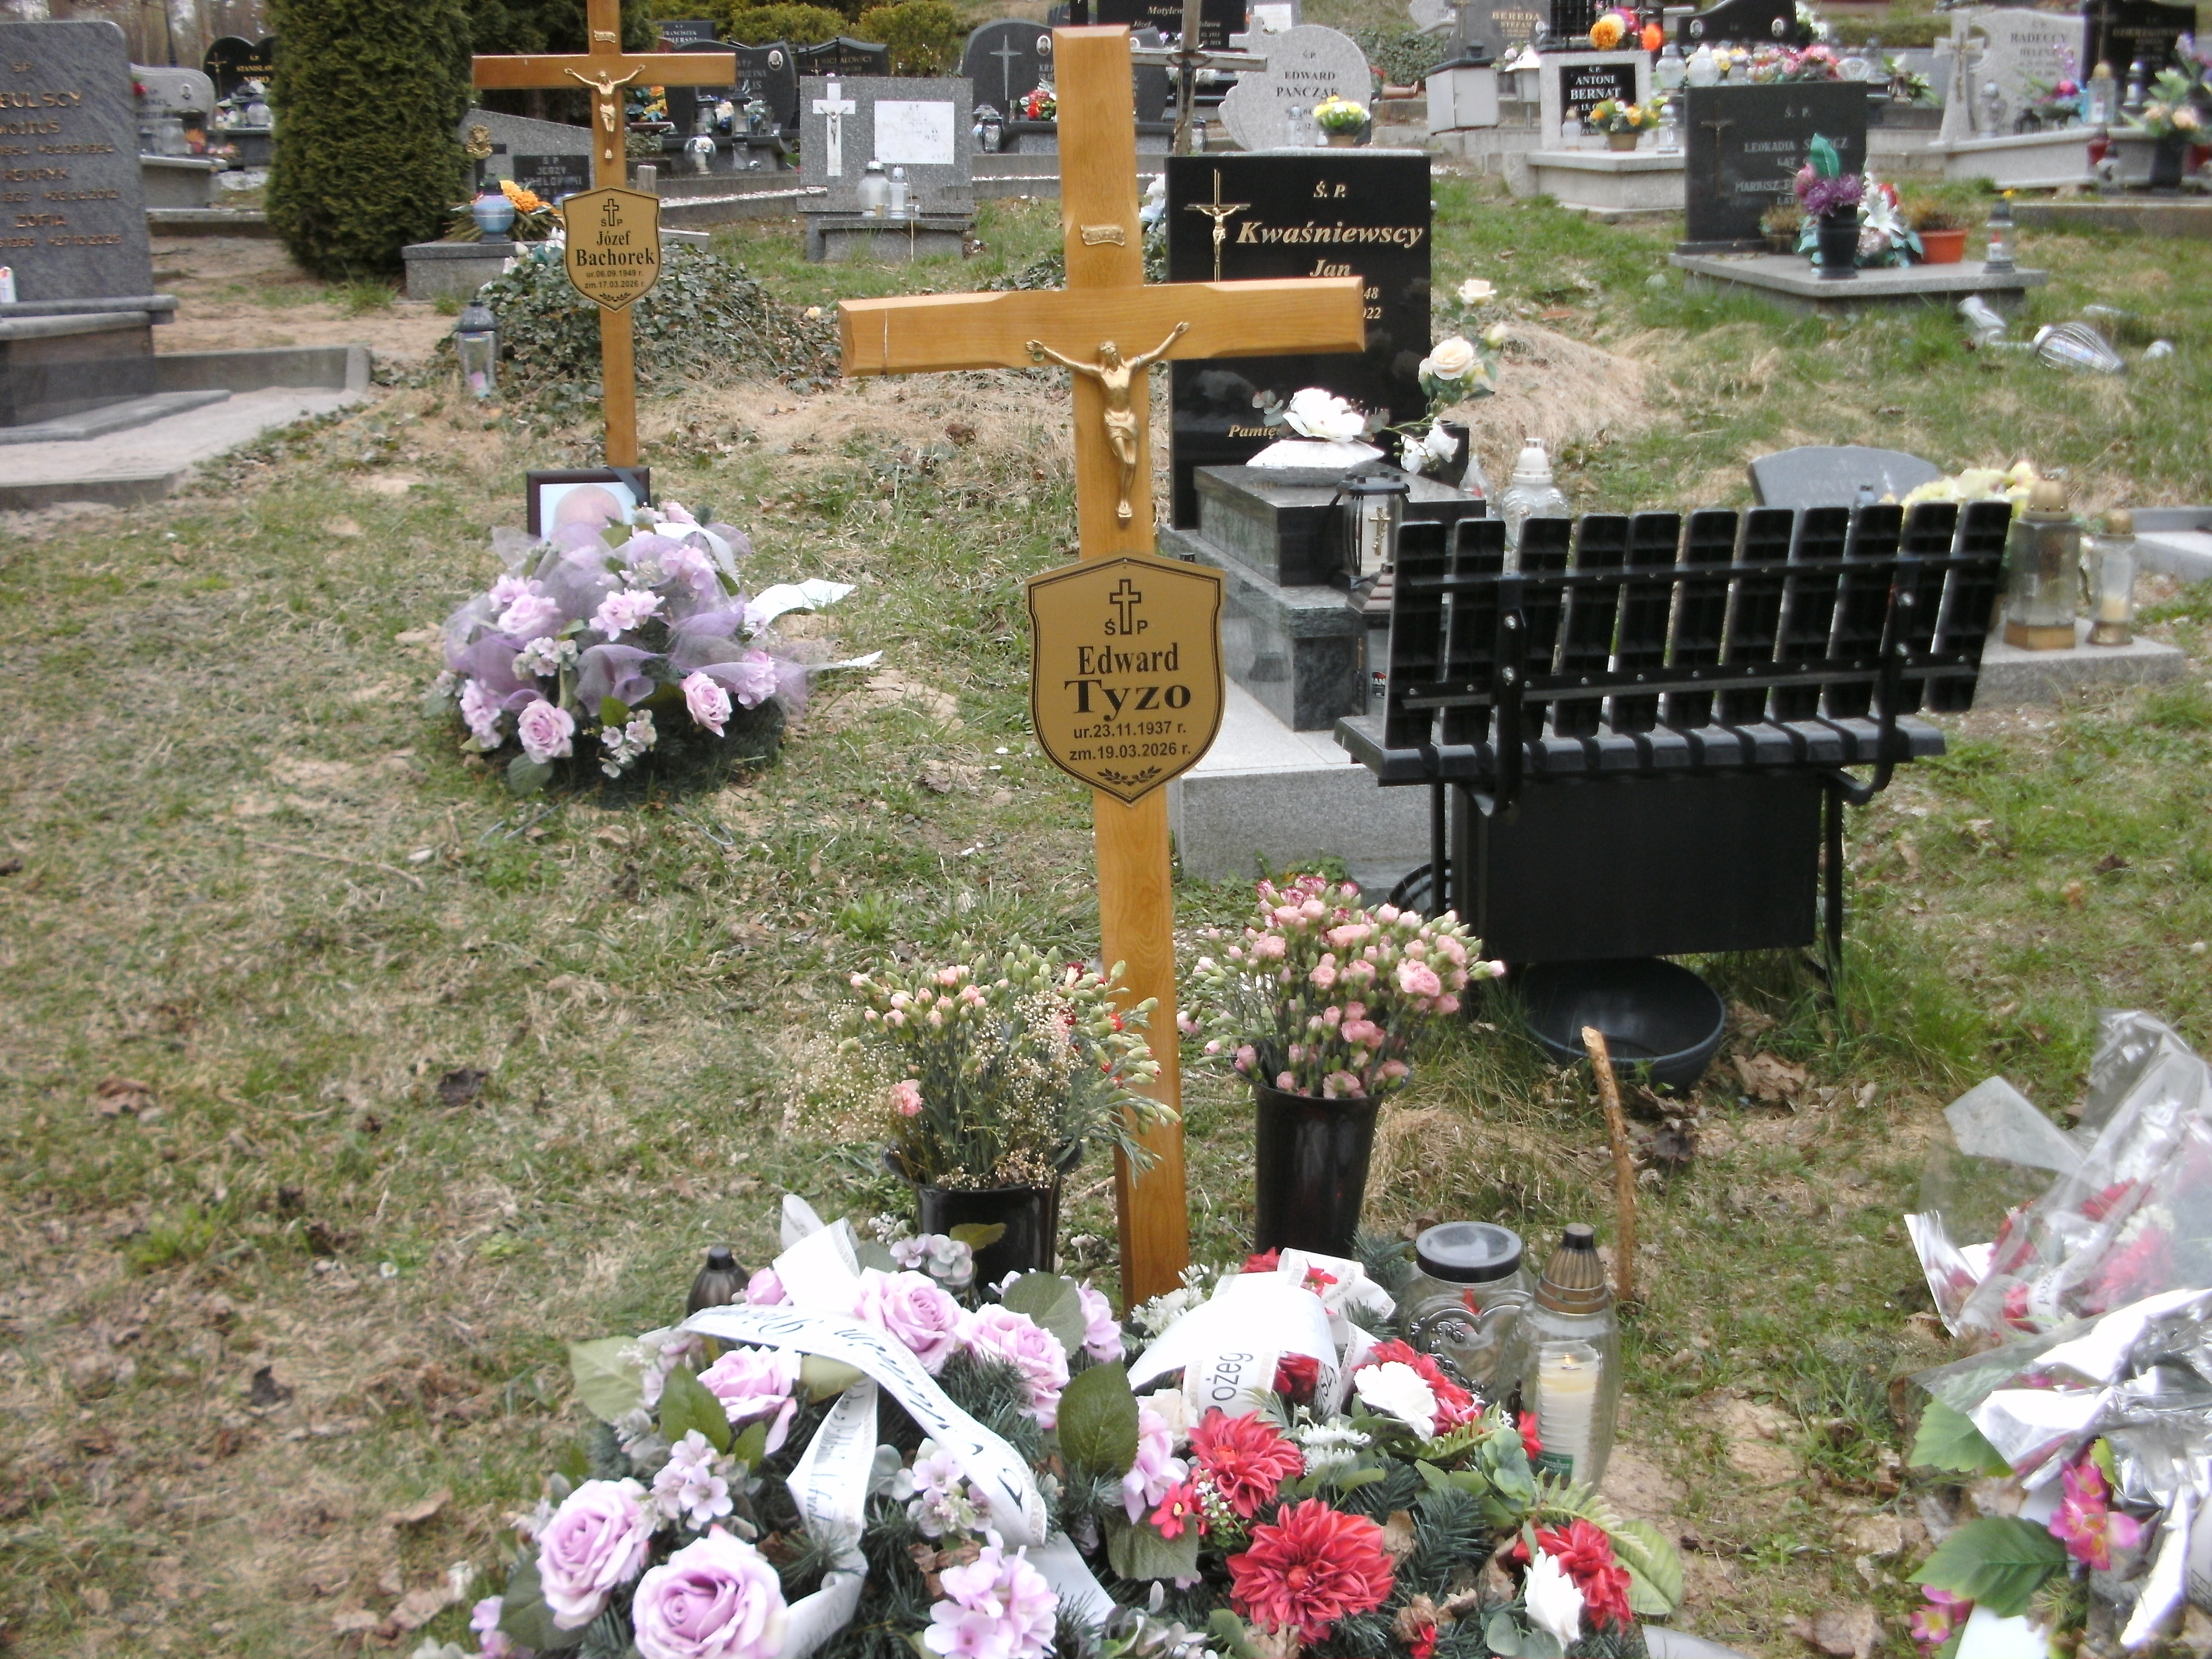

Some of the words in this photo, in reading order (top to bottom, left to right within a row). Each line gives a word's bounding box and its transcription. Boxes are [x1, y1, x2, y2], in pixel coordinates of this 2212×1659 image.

[1147, 7, 1182, 17] Motylew
[1284, 71, 1335, 80] EDWARD
[1575, 75, 1615, 85] ANTONI
[1570, 88, 1621, 100] BERNAT
[1777, 157, 1796, 166] LAT
[1735, 180, 1779, 192] MARIUSZ
[596, 230, 630, 245] Józef
[1236, 221, 1423, 248] Kwaśniewscy
[576, 248, 655, 266] Bachorek
[1309, 259, 1351, 278] Jan
[585, 280, 639, 289] zm.17.03.2026
[1363, 287, 1379, 299] 48
[1137, 620, 1148, 634] P
[1077, 642, 1179, 675] Edward
[1064, 679, 1191, 722] Tyzo
[1074, 721, 1172, 739] ur.23.11.1937
[1177, 723, 1186, 733] r.
[1069, 742, 1177, 761] zm.19.03.2026
[1182, 744, 1191, 755] r.
